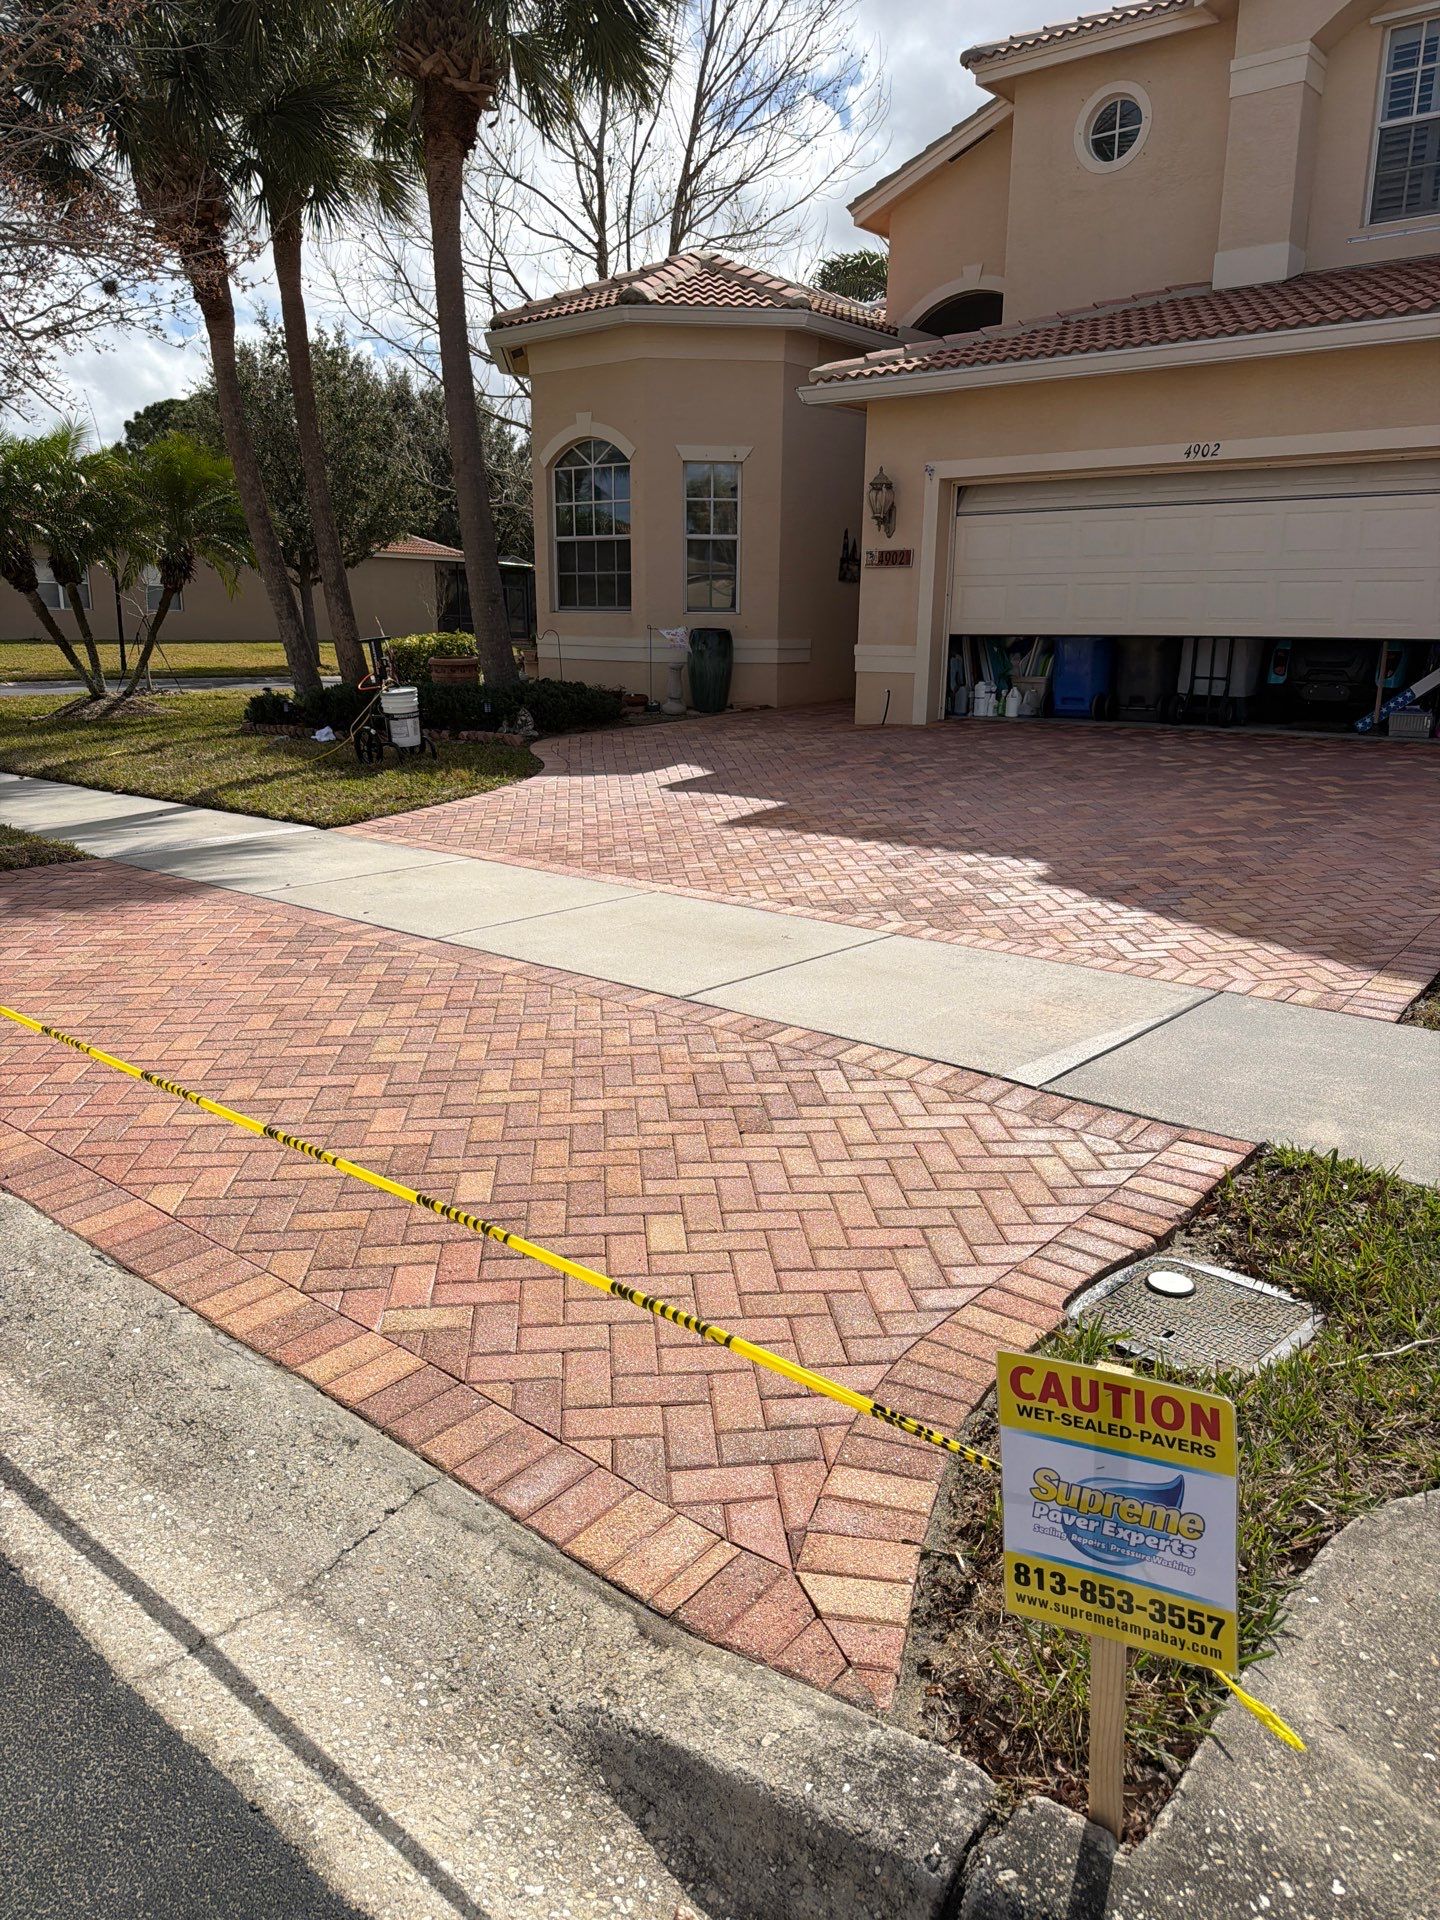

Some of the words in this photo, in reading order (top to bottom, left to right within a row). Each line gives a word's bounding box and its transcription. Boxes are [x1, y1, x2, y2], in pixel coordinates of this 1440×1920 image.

[1183, 443, 1221, 460] 4902
[878, 550, 905, 566] 4902
[1009, 1365, 1221, 1442] CAUTION
[1016, 1403, 1216, 1459] WET-SEALED-PAVERS
[1029, 1467, 1206, 1540] Supreme
[1032, 1501, 1100, 1536] Paver
[1101, 1516, 1198, 1559] Experts
[1109, 1543, 1151, 1562] Pressure
[1152, 1555, 1196, 1576] Washing
[1014, 1562, 1225, 1641] 813-853-3557
[1015, 1592, 1223, 1660] www.supremetampabay.com
